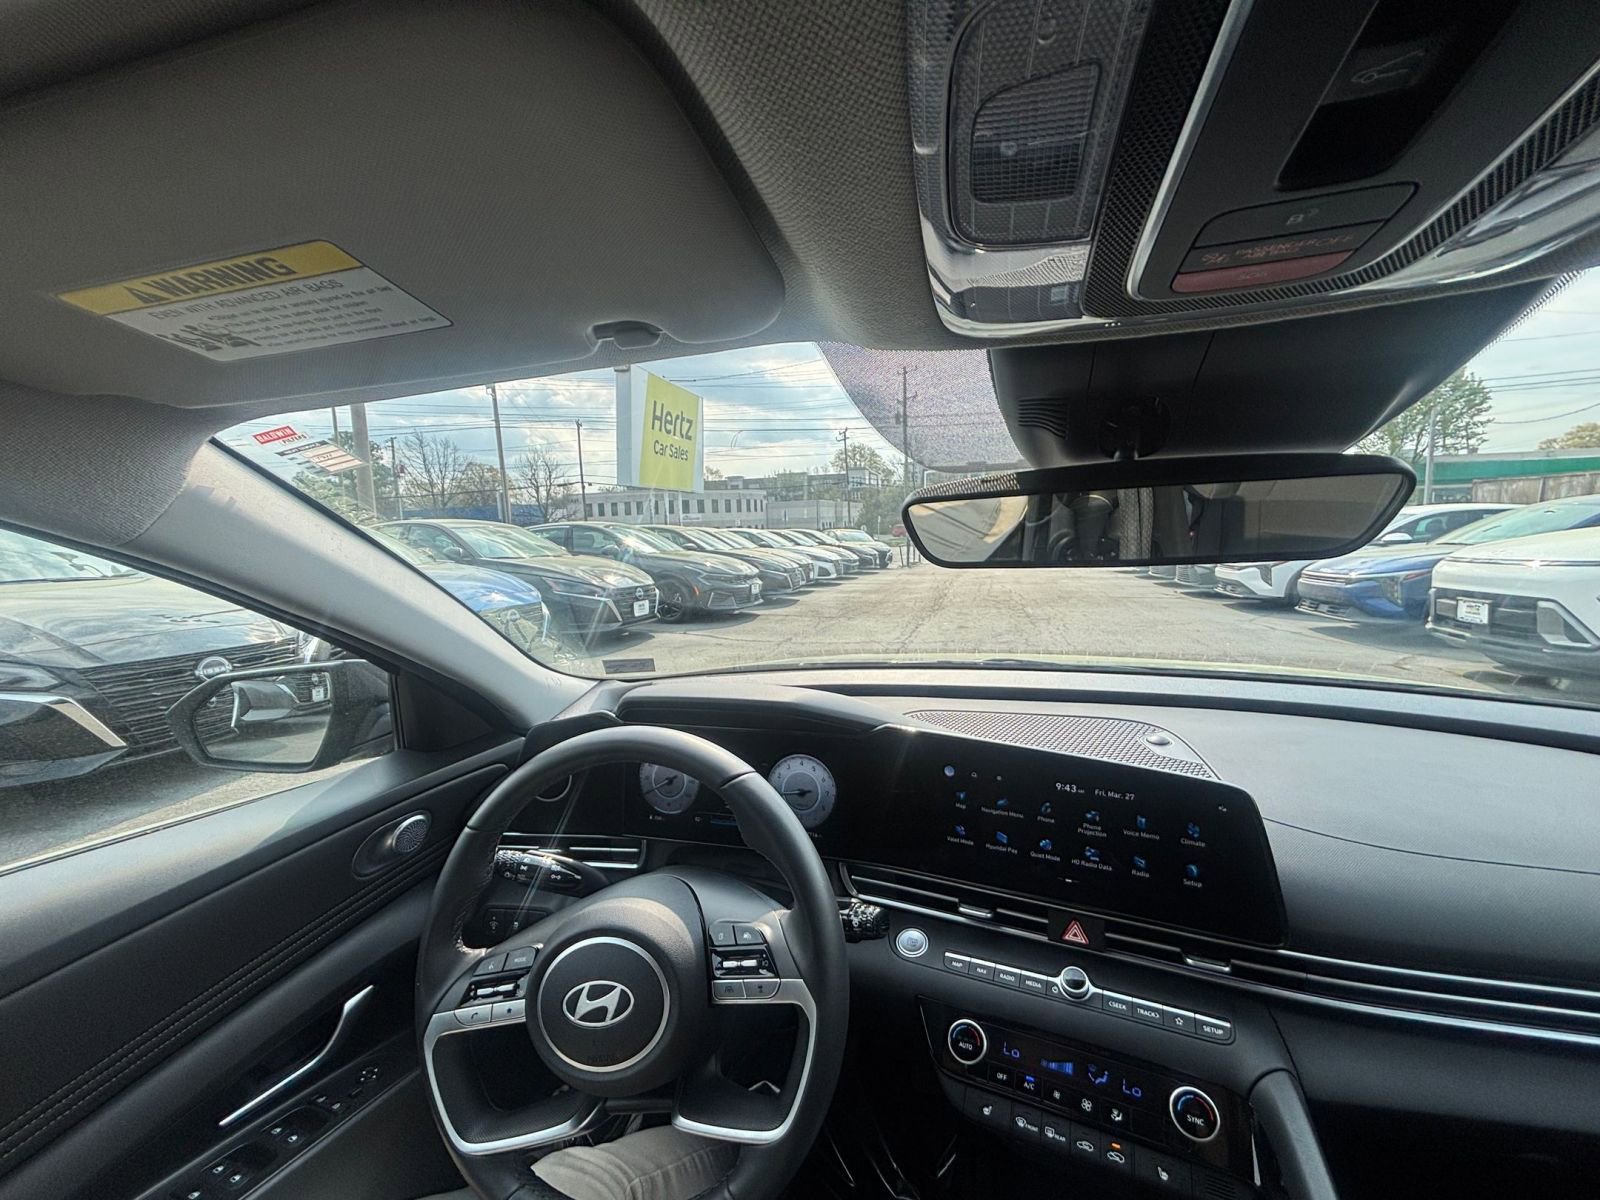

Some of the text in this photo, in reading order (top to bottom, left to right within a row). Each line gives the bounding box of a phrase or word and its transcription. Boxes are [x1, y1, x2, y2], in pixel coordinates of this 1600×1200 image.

[142, 257, 297, 297] WARNING
[184, 302, 218, 313] WITH
[214, 291, 280, 308] ADVANCED
[280, 286, 306, 297] AIR
[302, 279, 344, 293] BAGS
[651, 400, 693, 441] Hertz
[256, 427, 294, 442] BALDWIN
[653, 440, 689, 461] Car Sales
[1055, 782, 1077, 793] 9:43
[1107, 790, 1123, 800] Mar.
[981, 807, 1009, 816] Navigation
[1082, 822, 1101, 831] Phone
[1077, 828, 1107, 838] Projection
[1123, 829, 1160, 841] Voice Memo
[960, 837, 974, 846] Mode
[1180, 837, 1206, 847] Climate
[985, 843, 1007, 853] Hyundai
[1030, 851, 1061, 862] Quiet Mode
[1080, 859, 1098, 869] Radio
[1099, 863, 1113, 872] Data
[1131, 869, 1150, 878] Radio
[1183, 878, 1203, 888] Setup
[999, 973, 1015, 982] RADIO
[1025, 979, 1042, 988] MEDIA
[1202, 1025, 1224, 1035] SETUP
[958, 1041, 973, 1051] AUTO
[1003, 1041, 1020, 1058] Lo
[996, 1072, 1008, 1081] OFF
[1023, 1081, 1035, 1091] A/C
[1122, 1079, 1142, 1097] Lo
[1186, 1114, 1205, 1127] SYNC
[1025, 1123, 1039, 1133] FRONT
[1054, 1133, 1066, 1142] REAR
